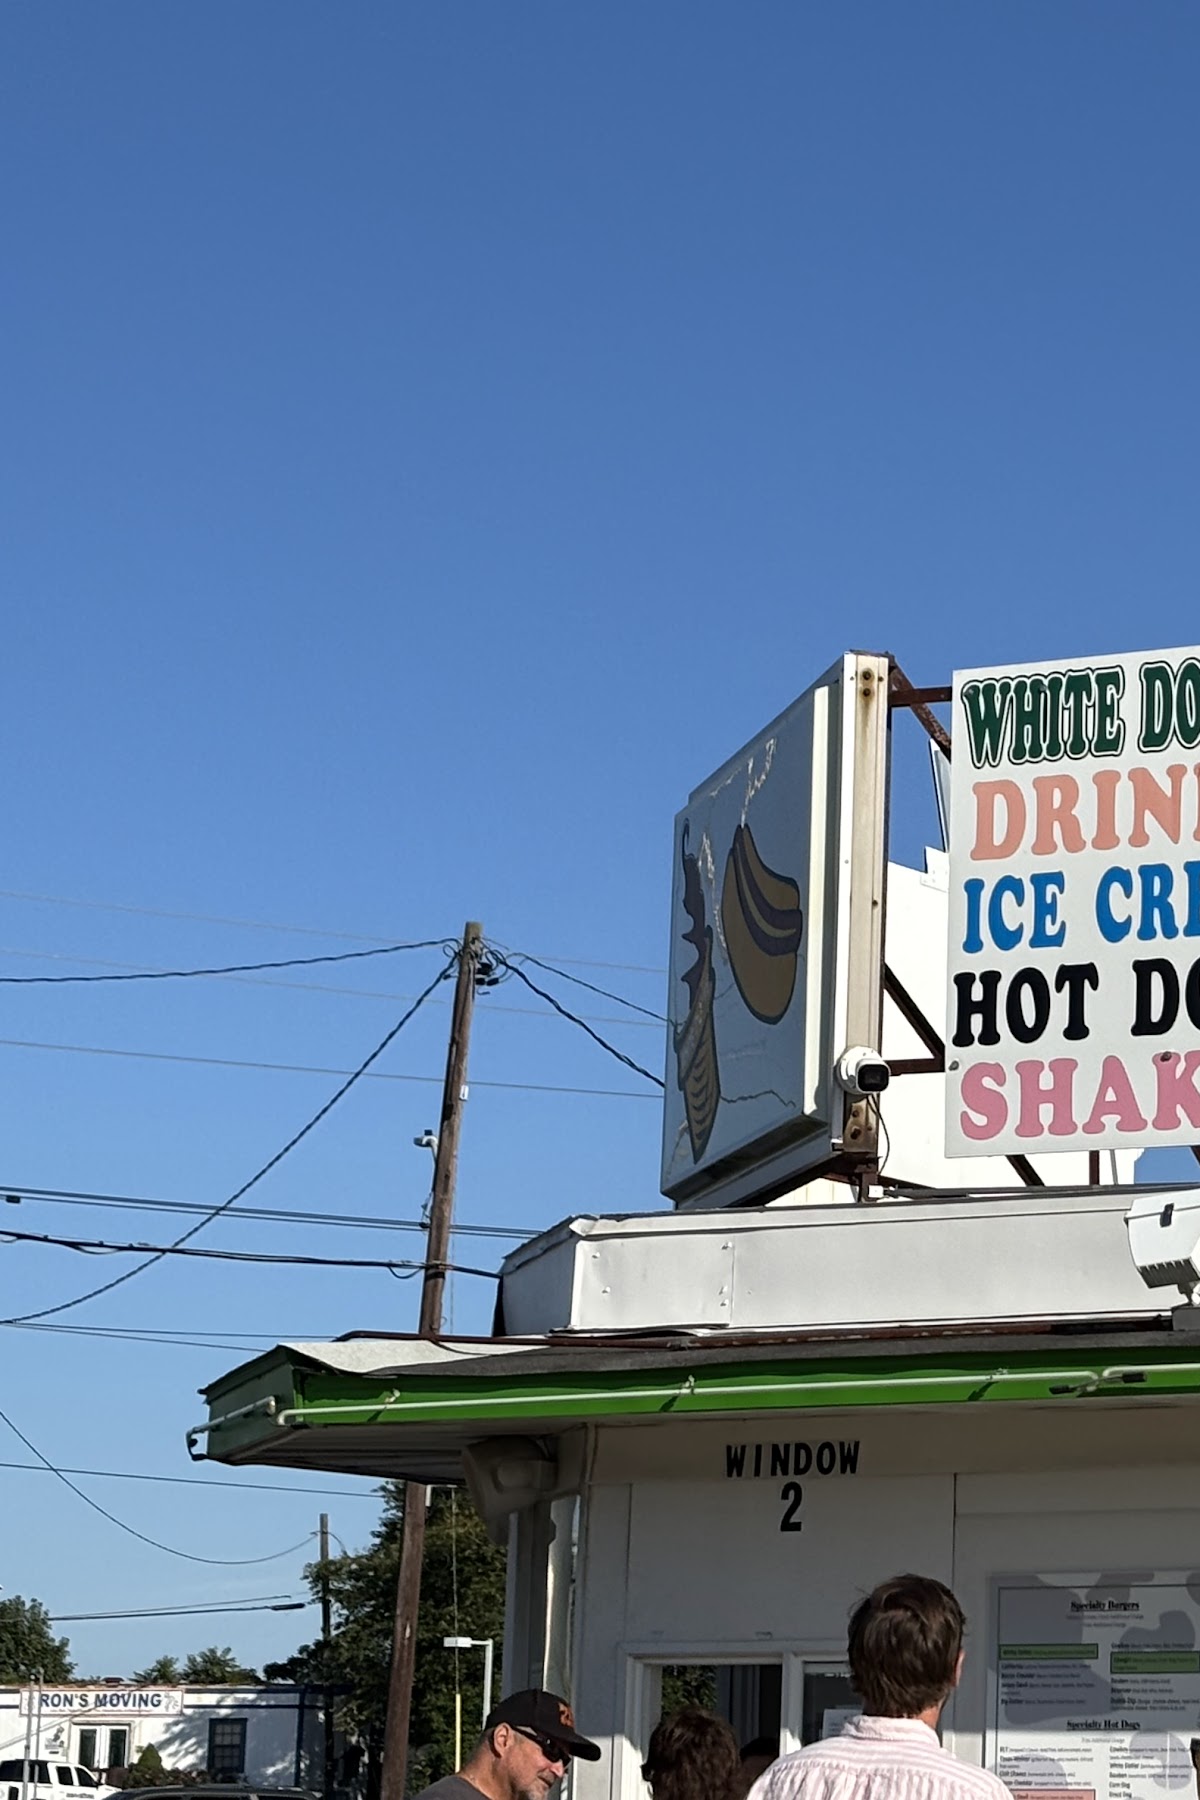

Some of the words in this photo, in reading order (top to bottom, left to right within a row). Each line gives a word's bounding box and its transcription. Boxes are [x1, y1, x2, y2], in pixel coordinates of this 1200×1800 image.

[961, 664, 1124, 768] WHITE
[962, 869, 1067, 955] ICE
[952, 961, 1099, 1048] HOT
[725, 1440, 861, 1478] WINDOW
[780, 1481, 803, 1532] 2
[40, 1693, 88, 1708] RON'S
[94, 1693, 162, 1708] MOVING
